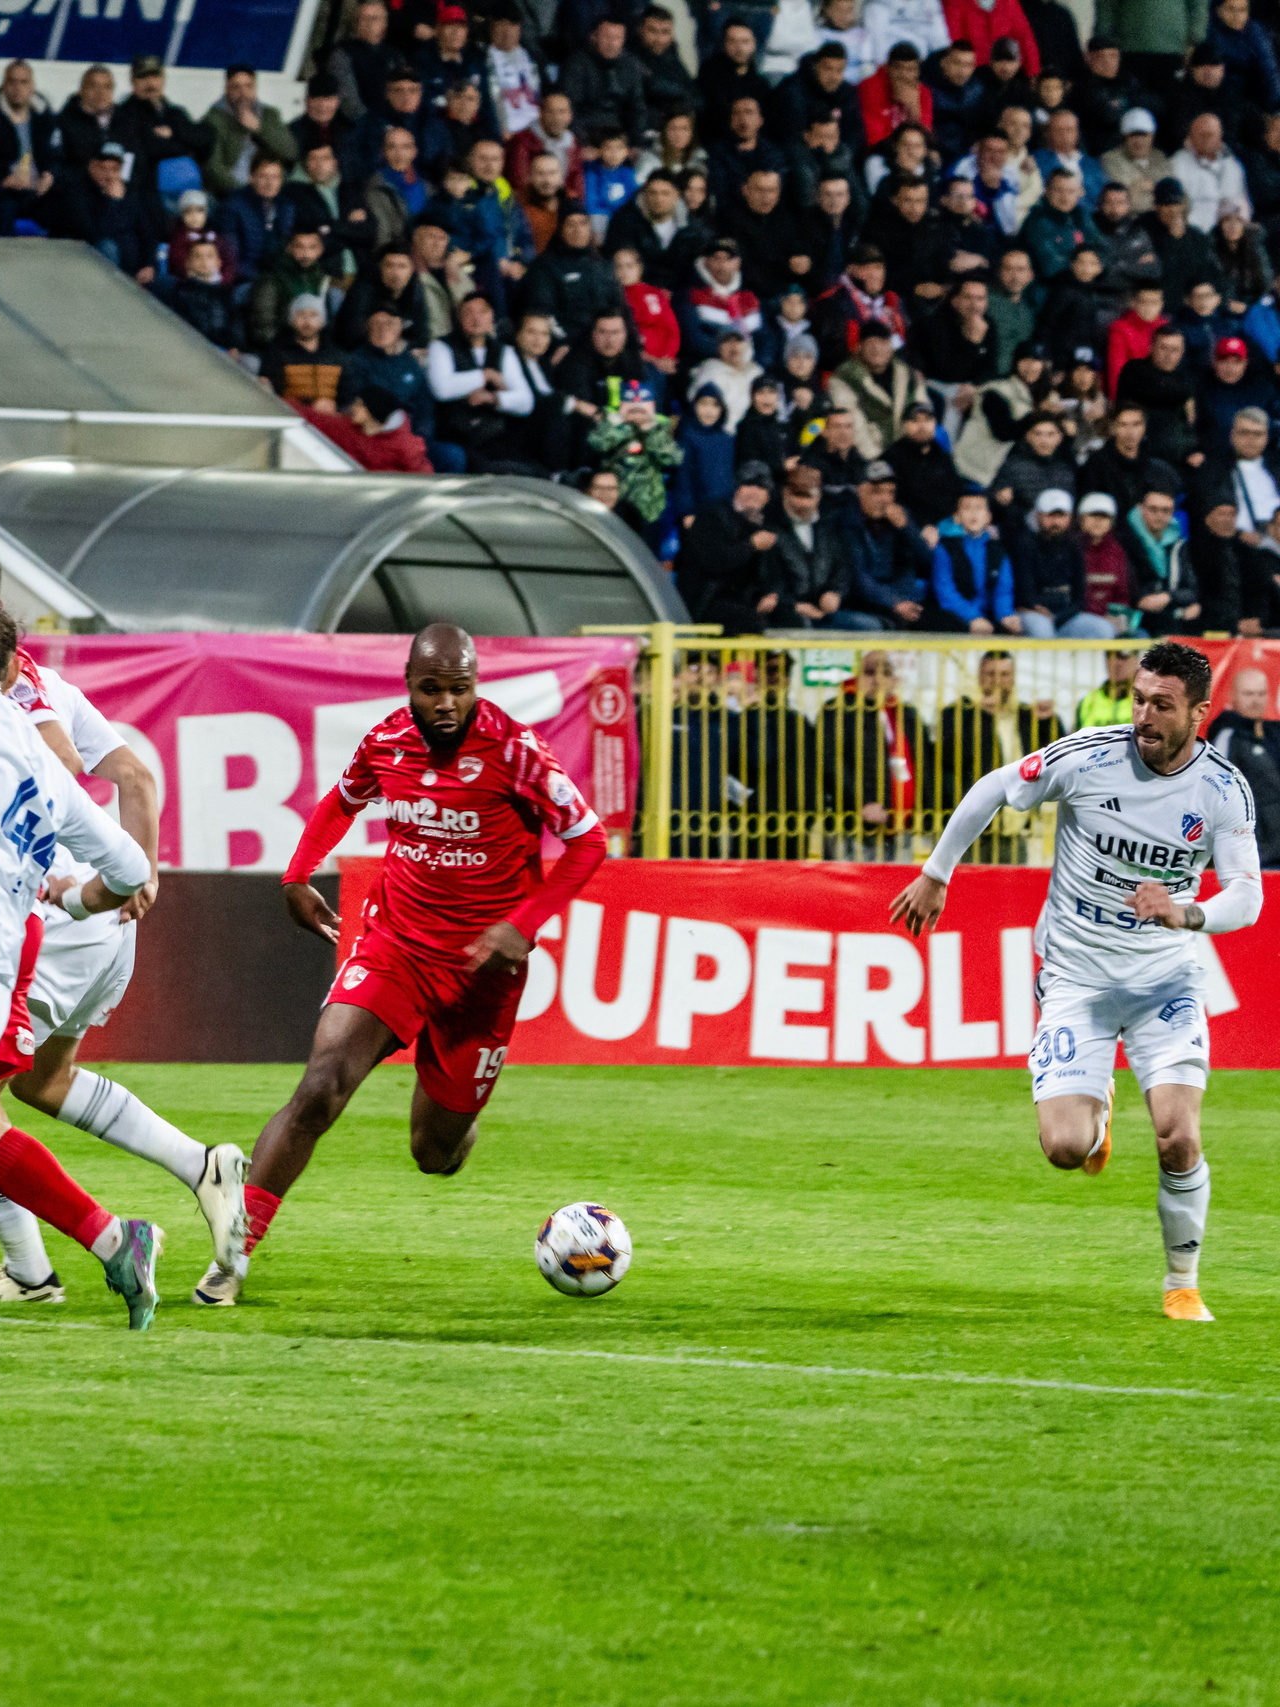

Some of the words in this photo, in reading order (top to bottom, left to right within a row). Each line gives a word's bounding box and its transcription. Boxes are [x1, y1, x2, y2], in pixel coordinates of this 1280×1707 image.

[1095, 833, 1206, 869] UNIBET
[515, 898, 1240, 1064] UPERLI
[474, 1046, 508, 1079] 19
[1038, 1026, 1077, 1068] 30
